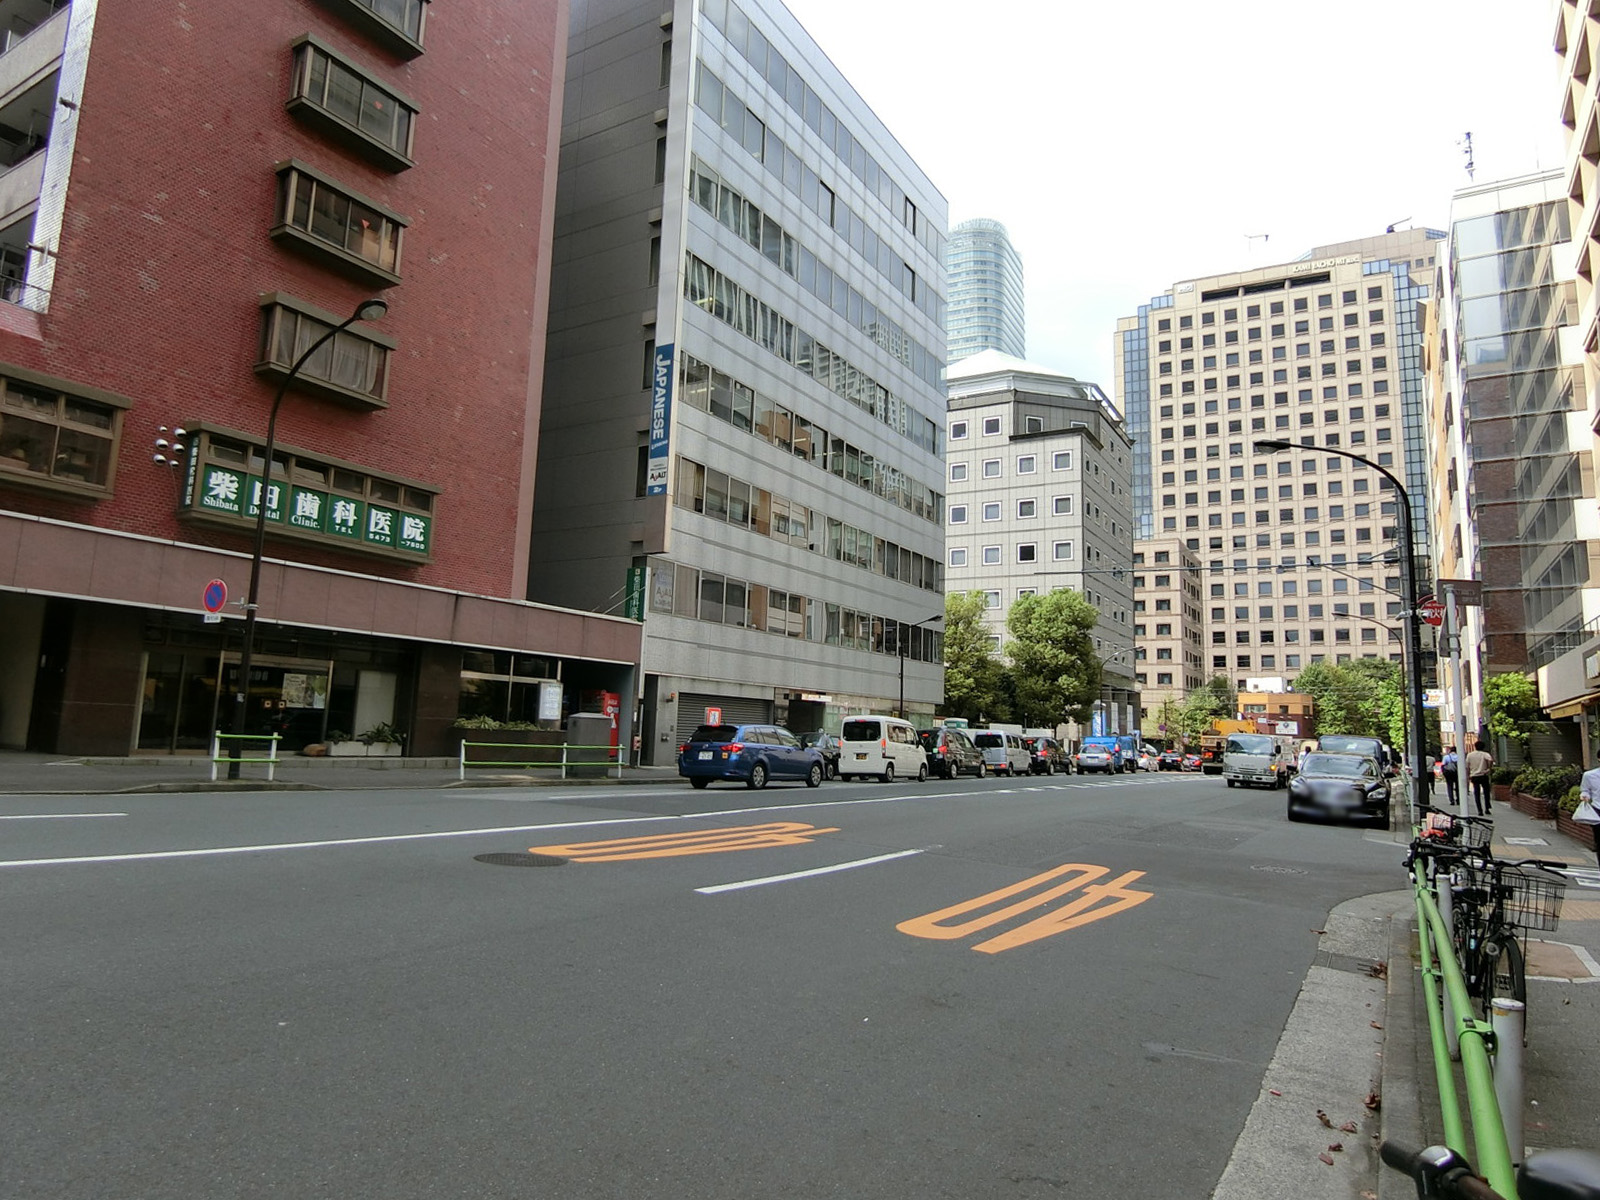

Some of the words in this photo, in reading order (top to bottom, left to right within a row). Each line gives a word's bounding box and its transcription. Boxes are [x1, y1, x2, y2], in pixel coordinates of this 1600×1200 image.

[652, 353, 671, 440] JAPANESE
[203, 496, 239, 511] Shibata
[335, 525, 353, 534] TEL
